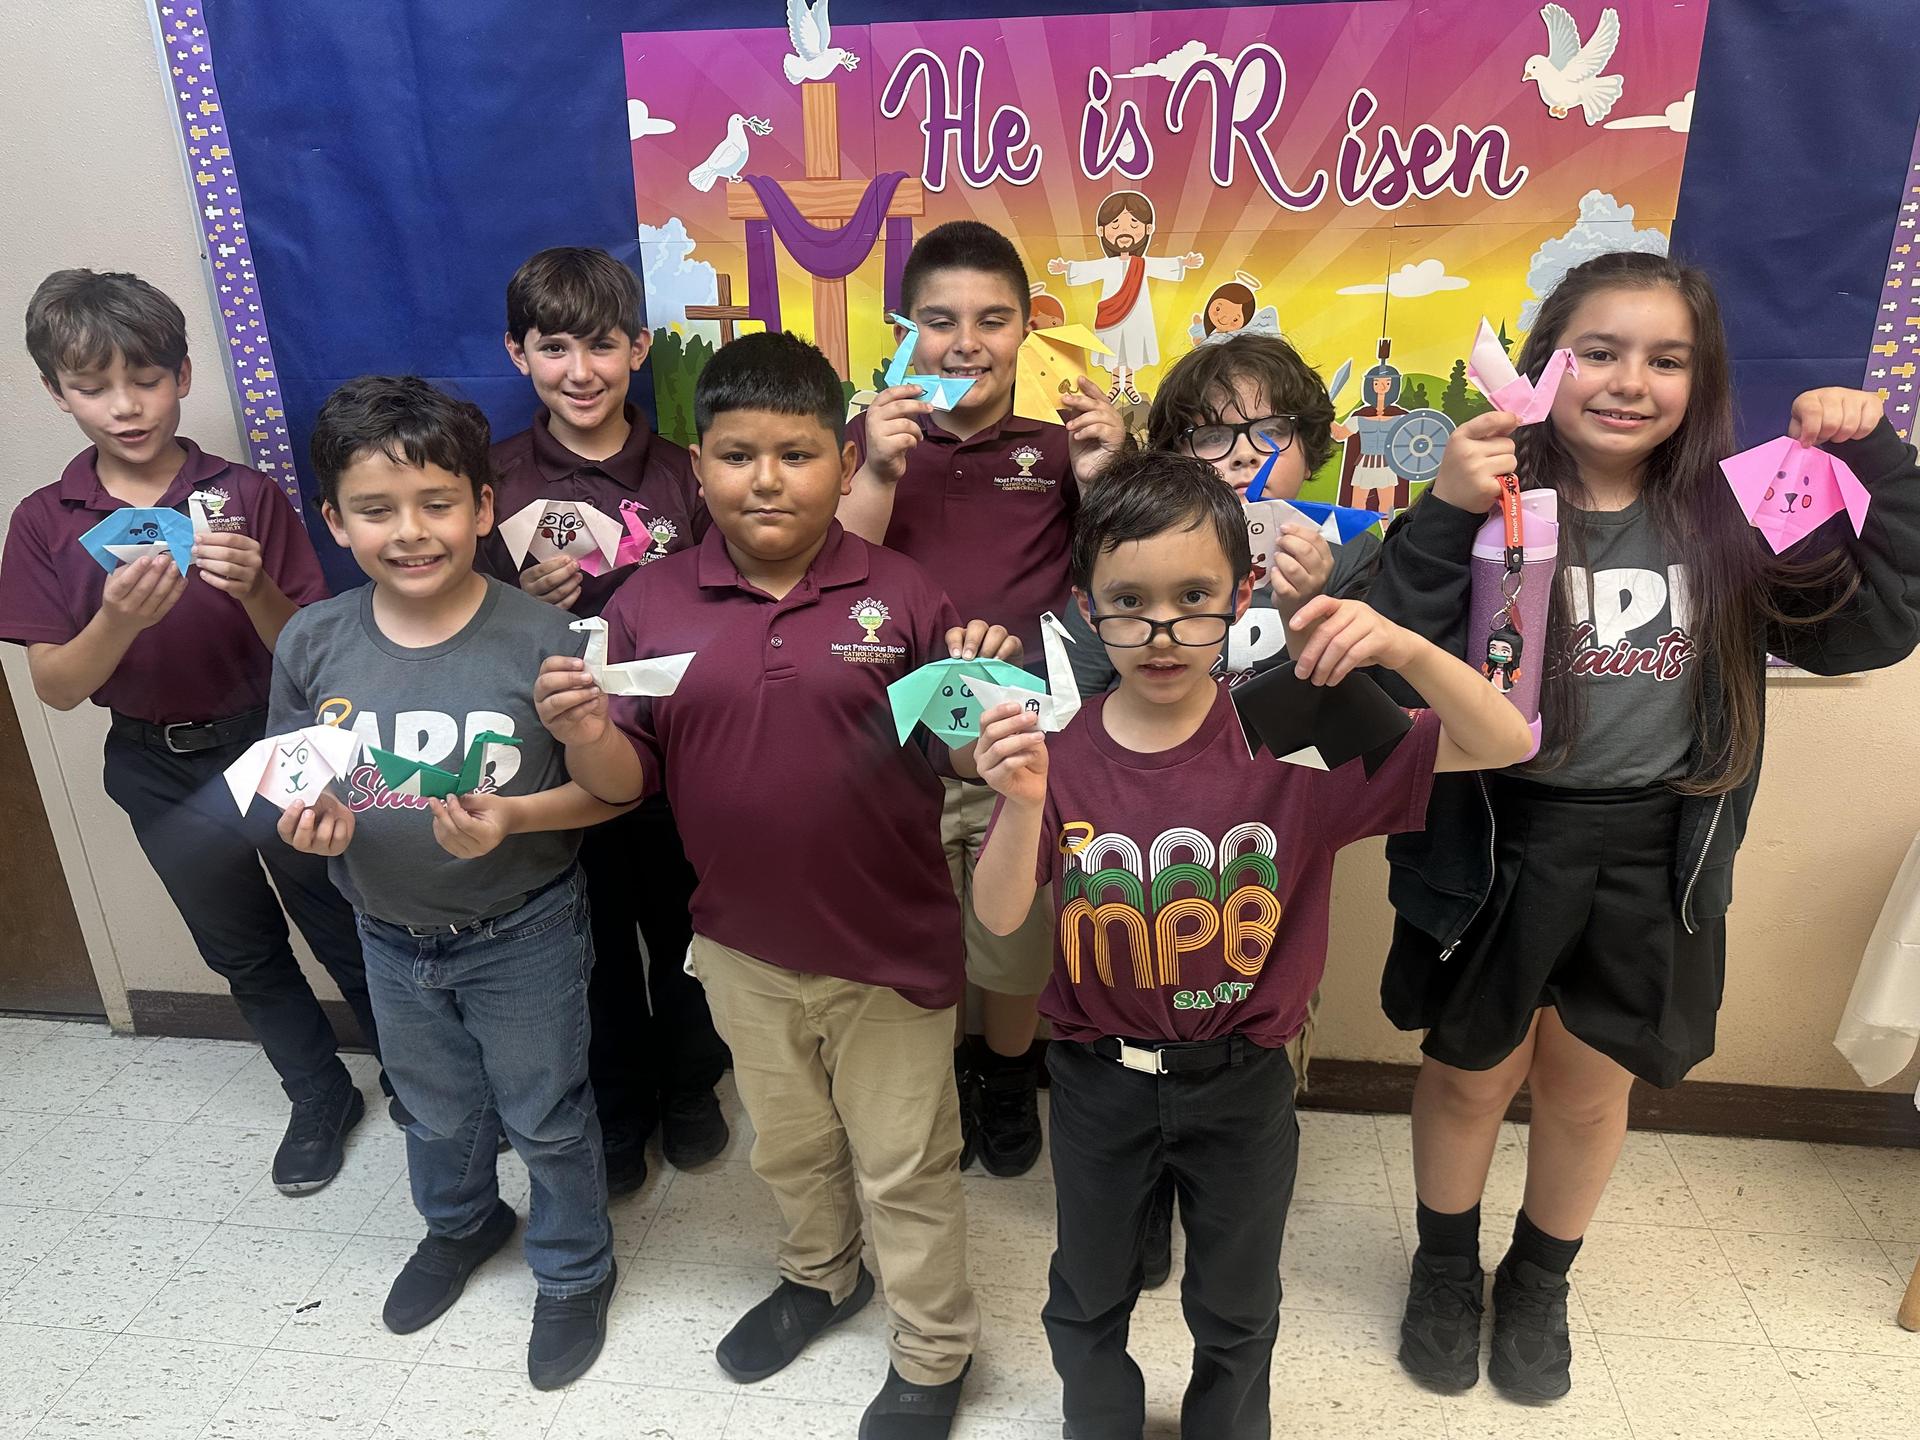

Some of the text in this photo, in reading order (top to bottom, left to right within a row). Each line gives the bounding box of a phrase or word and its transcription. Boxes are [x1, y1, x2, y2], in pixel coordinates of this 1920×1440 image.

[881, 46, 1042, 192] He
[1080, 67, 1154, 180] is
[1510, 496, 1518, 517] Slayer
[831, 643, 852, 651] Most
[853, 644, 886, 653] Precious
[1173, 982, 1254, 1009] SANT
